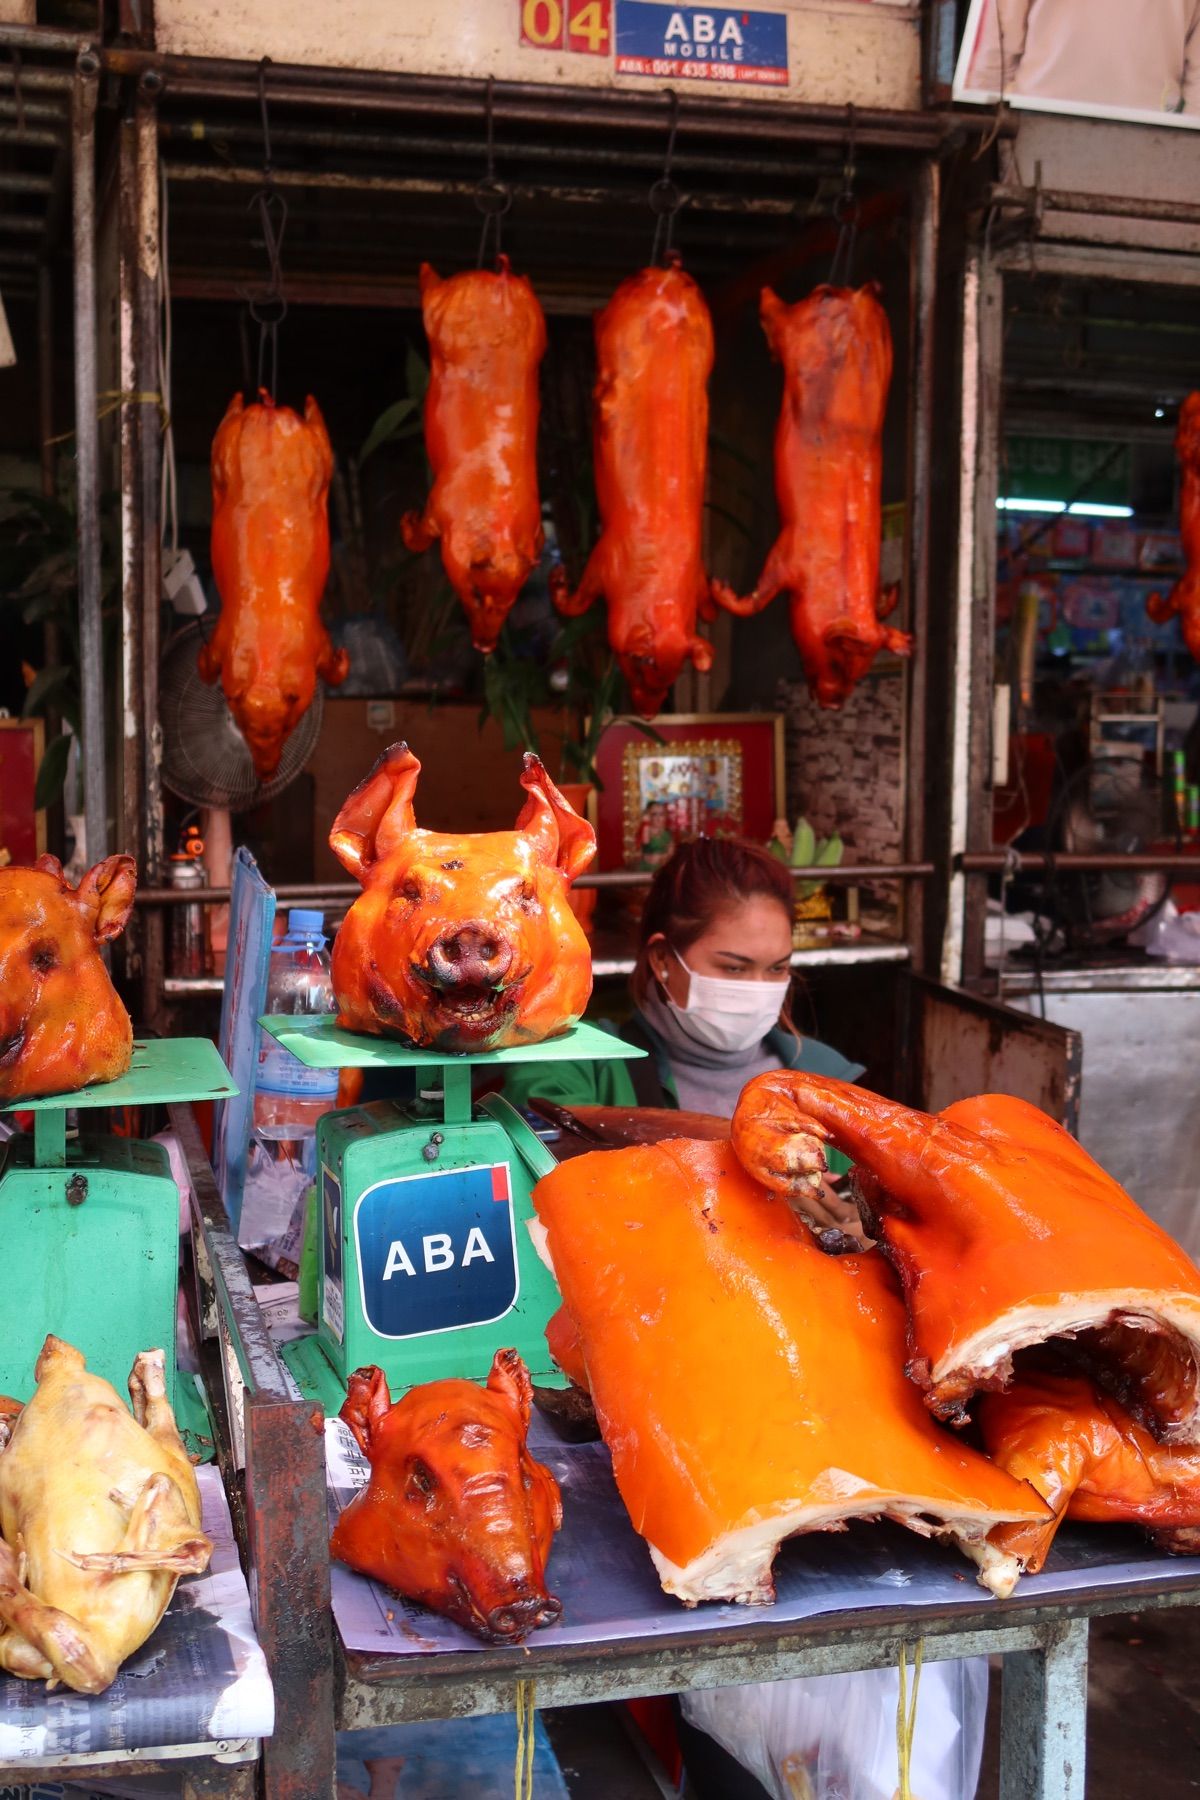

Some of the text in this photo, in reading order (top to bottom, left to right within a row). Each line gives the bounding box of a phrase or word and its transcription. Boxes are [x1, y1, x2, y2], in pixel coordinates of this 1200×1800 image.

[521, 0, 608, 51] 04
[664, 13, 744, 46] ABA
[663, 42, 744, 61] MOBILE
[382, 1227, 495, 1281] ABA
